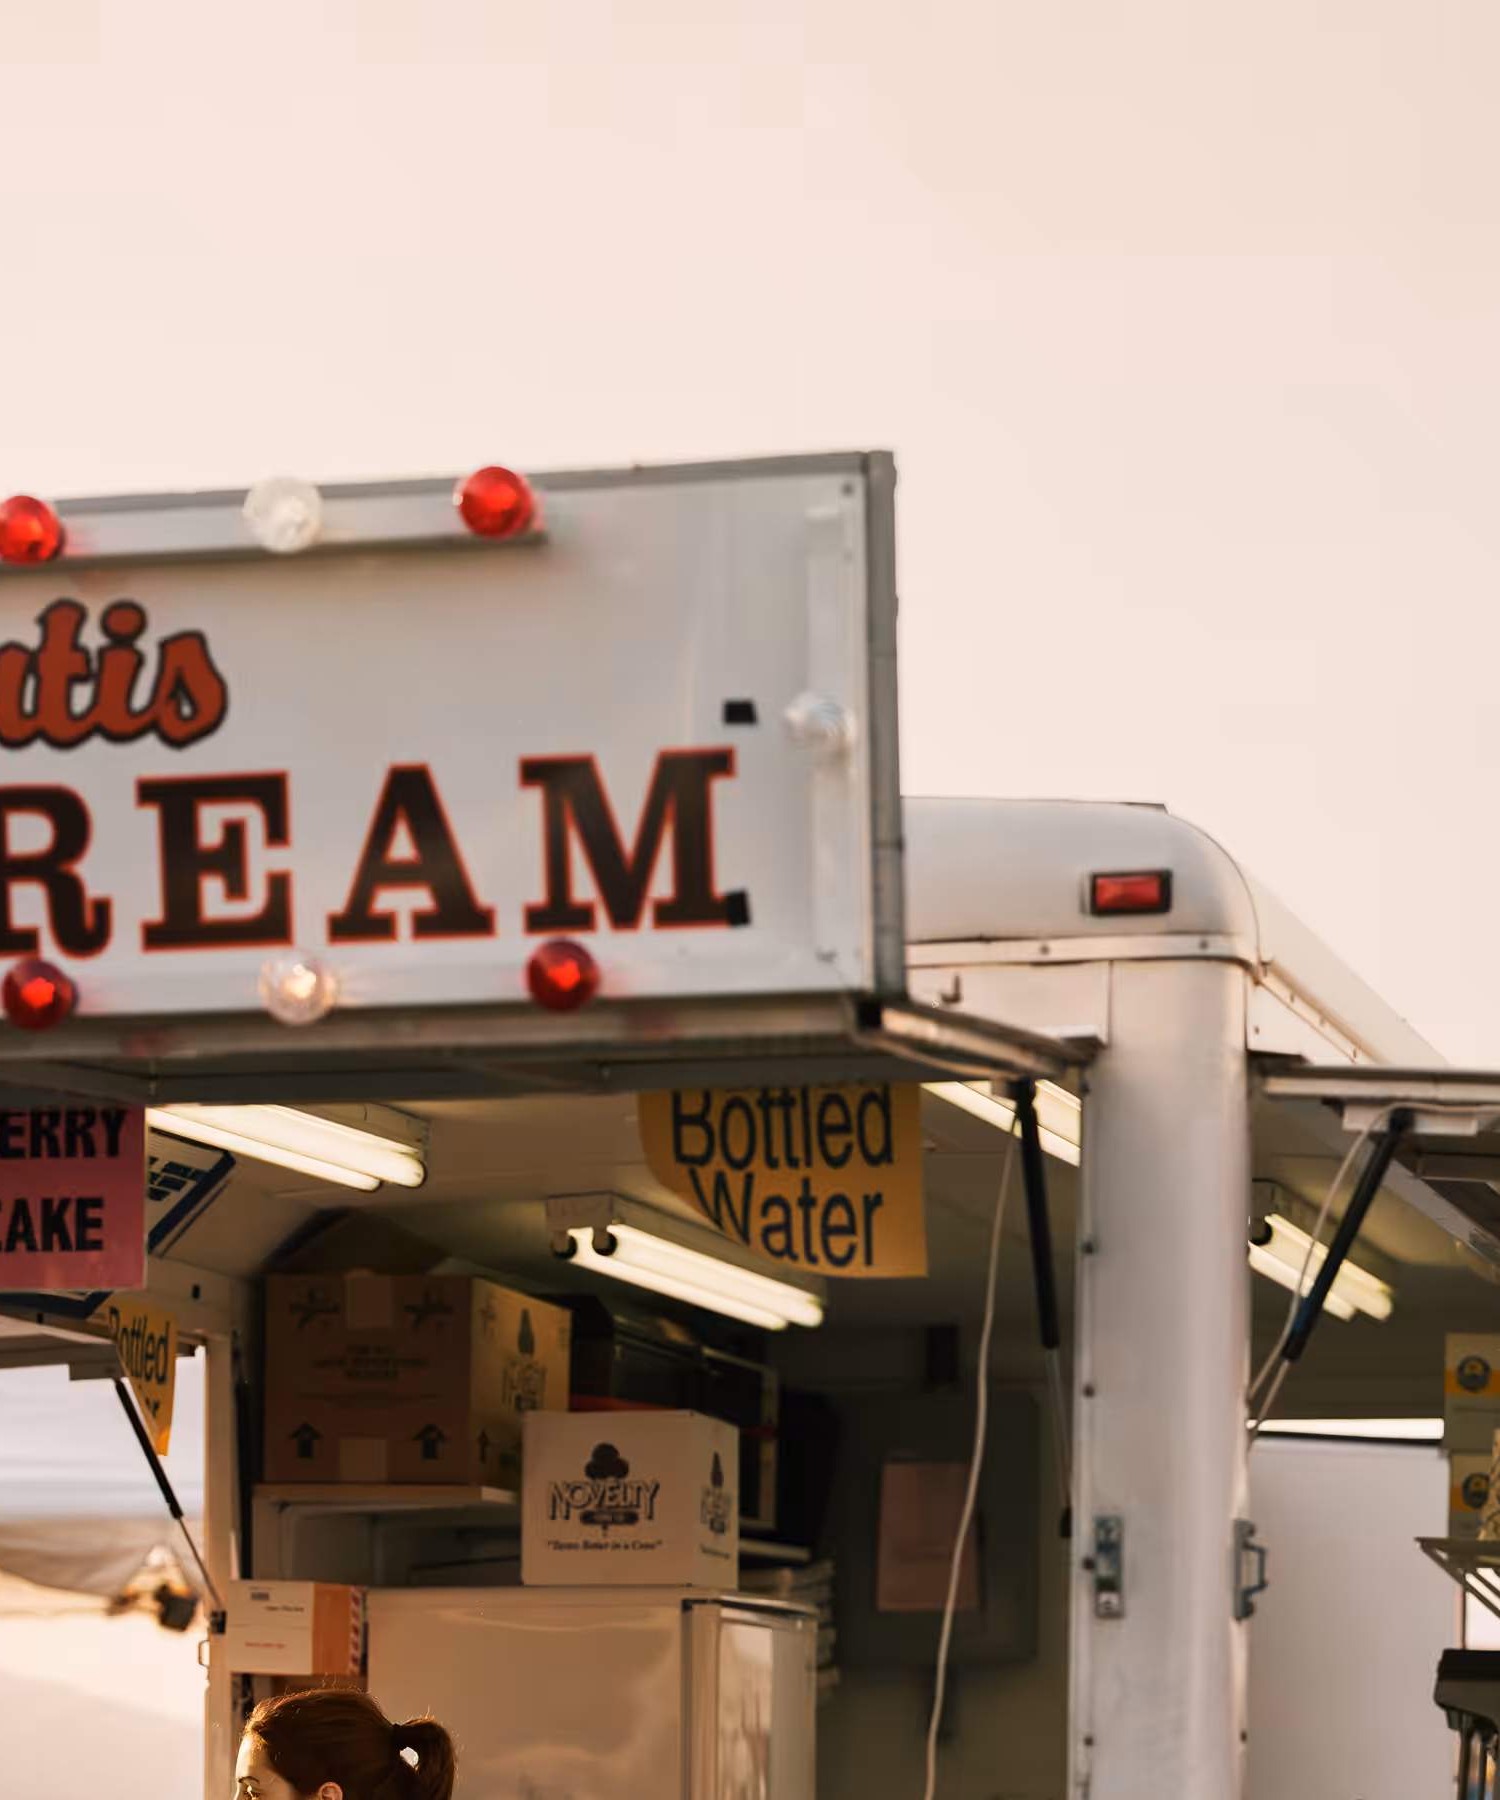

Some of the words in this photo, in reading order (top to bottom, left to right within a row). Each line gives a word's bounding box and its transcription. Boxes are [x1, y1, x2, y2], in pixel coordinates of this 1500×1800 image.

[673, 1085, 894, 1173] Bottled
[690, 1168, 885, 1270] Water
[547, 1478, 660, 1521] NOVELTY
